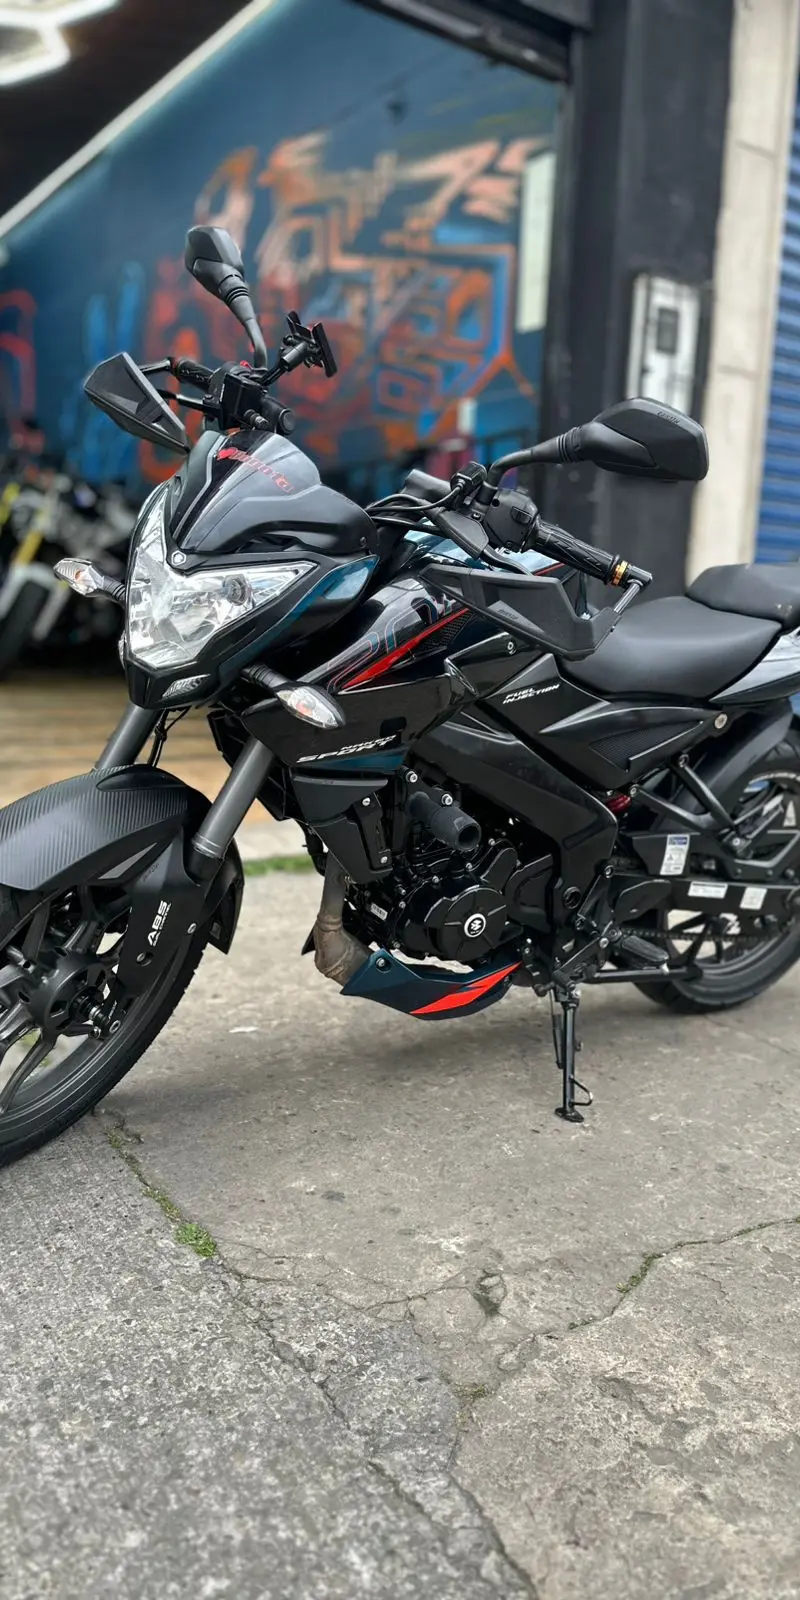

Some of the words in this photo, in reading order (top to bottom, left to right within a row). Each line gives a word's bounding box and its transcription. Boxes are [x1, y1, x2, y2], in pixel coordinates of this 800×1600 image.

[502, 684, 560, 704] INJECTION
[505, 687, 533, 699] FUEL
[296, 738, 394, 763] SPORT
[147, 900, 168, 946] ABS
